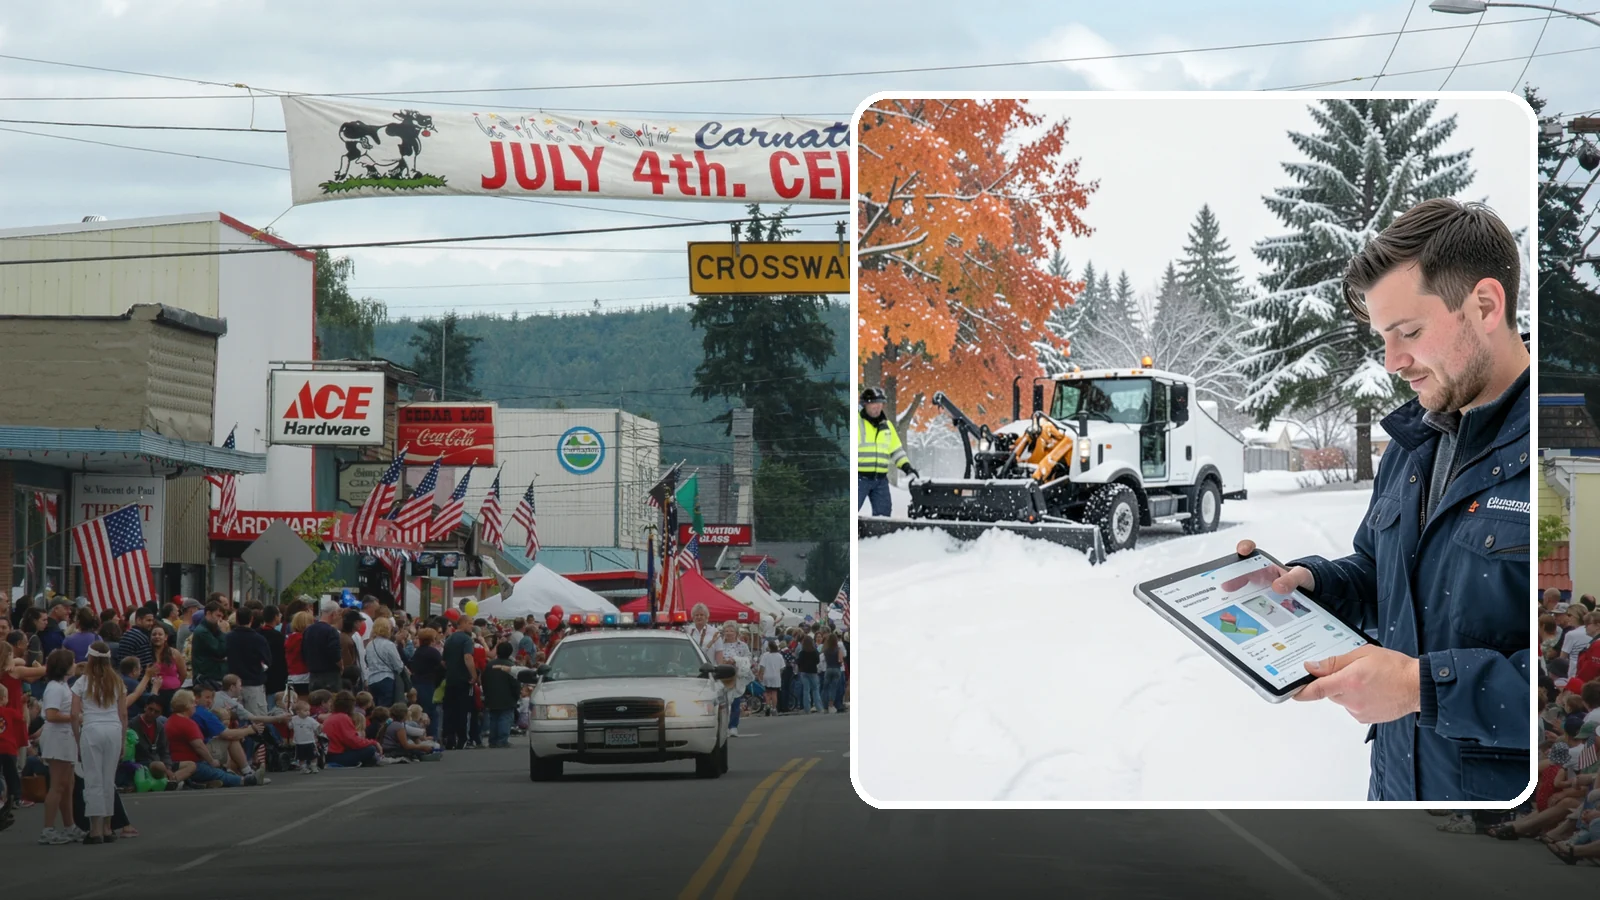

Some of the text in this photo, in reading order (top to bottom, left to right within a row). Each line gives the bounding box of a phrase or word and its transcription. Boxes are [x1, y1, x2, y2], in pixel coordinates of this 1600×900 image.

[695, 121, 850, 149] Carnat
[481, 141, 605, 192] JULY
[632, 150, 746, 198] 4th.
[697, 254, 850, 280] CROSSWA
[283, 380, 374, 420] ACE
[406, 409, 485, 422] CEDAR LOG
[283, 421, 371, 436] Hardware
[95, 485, 124, 495] Vincent
[126, 486, 136, 495] de
[137, 486, 155, 495] Paul
[688, 526, 741, 535] CRNATION
